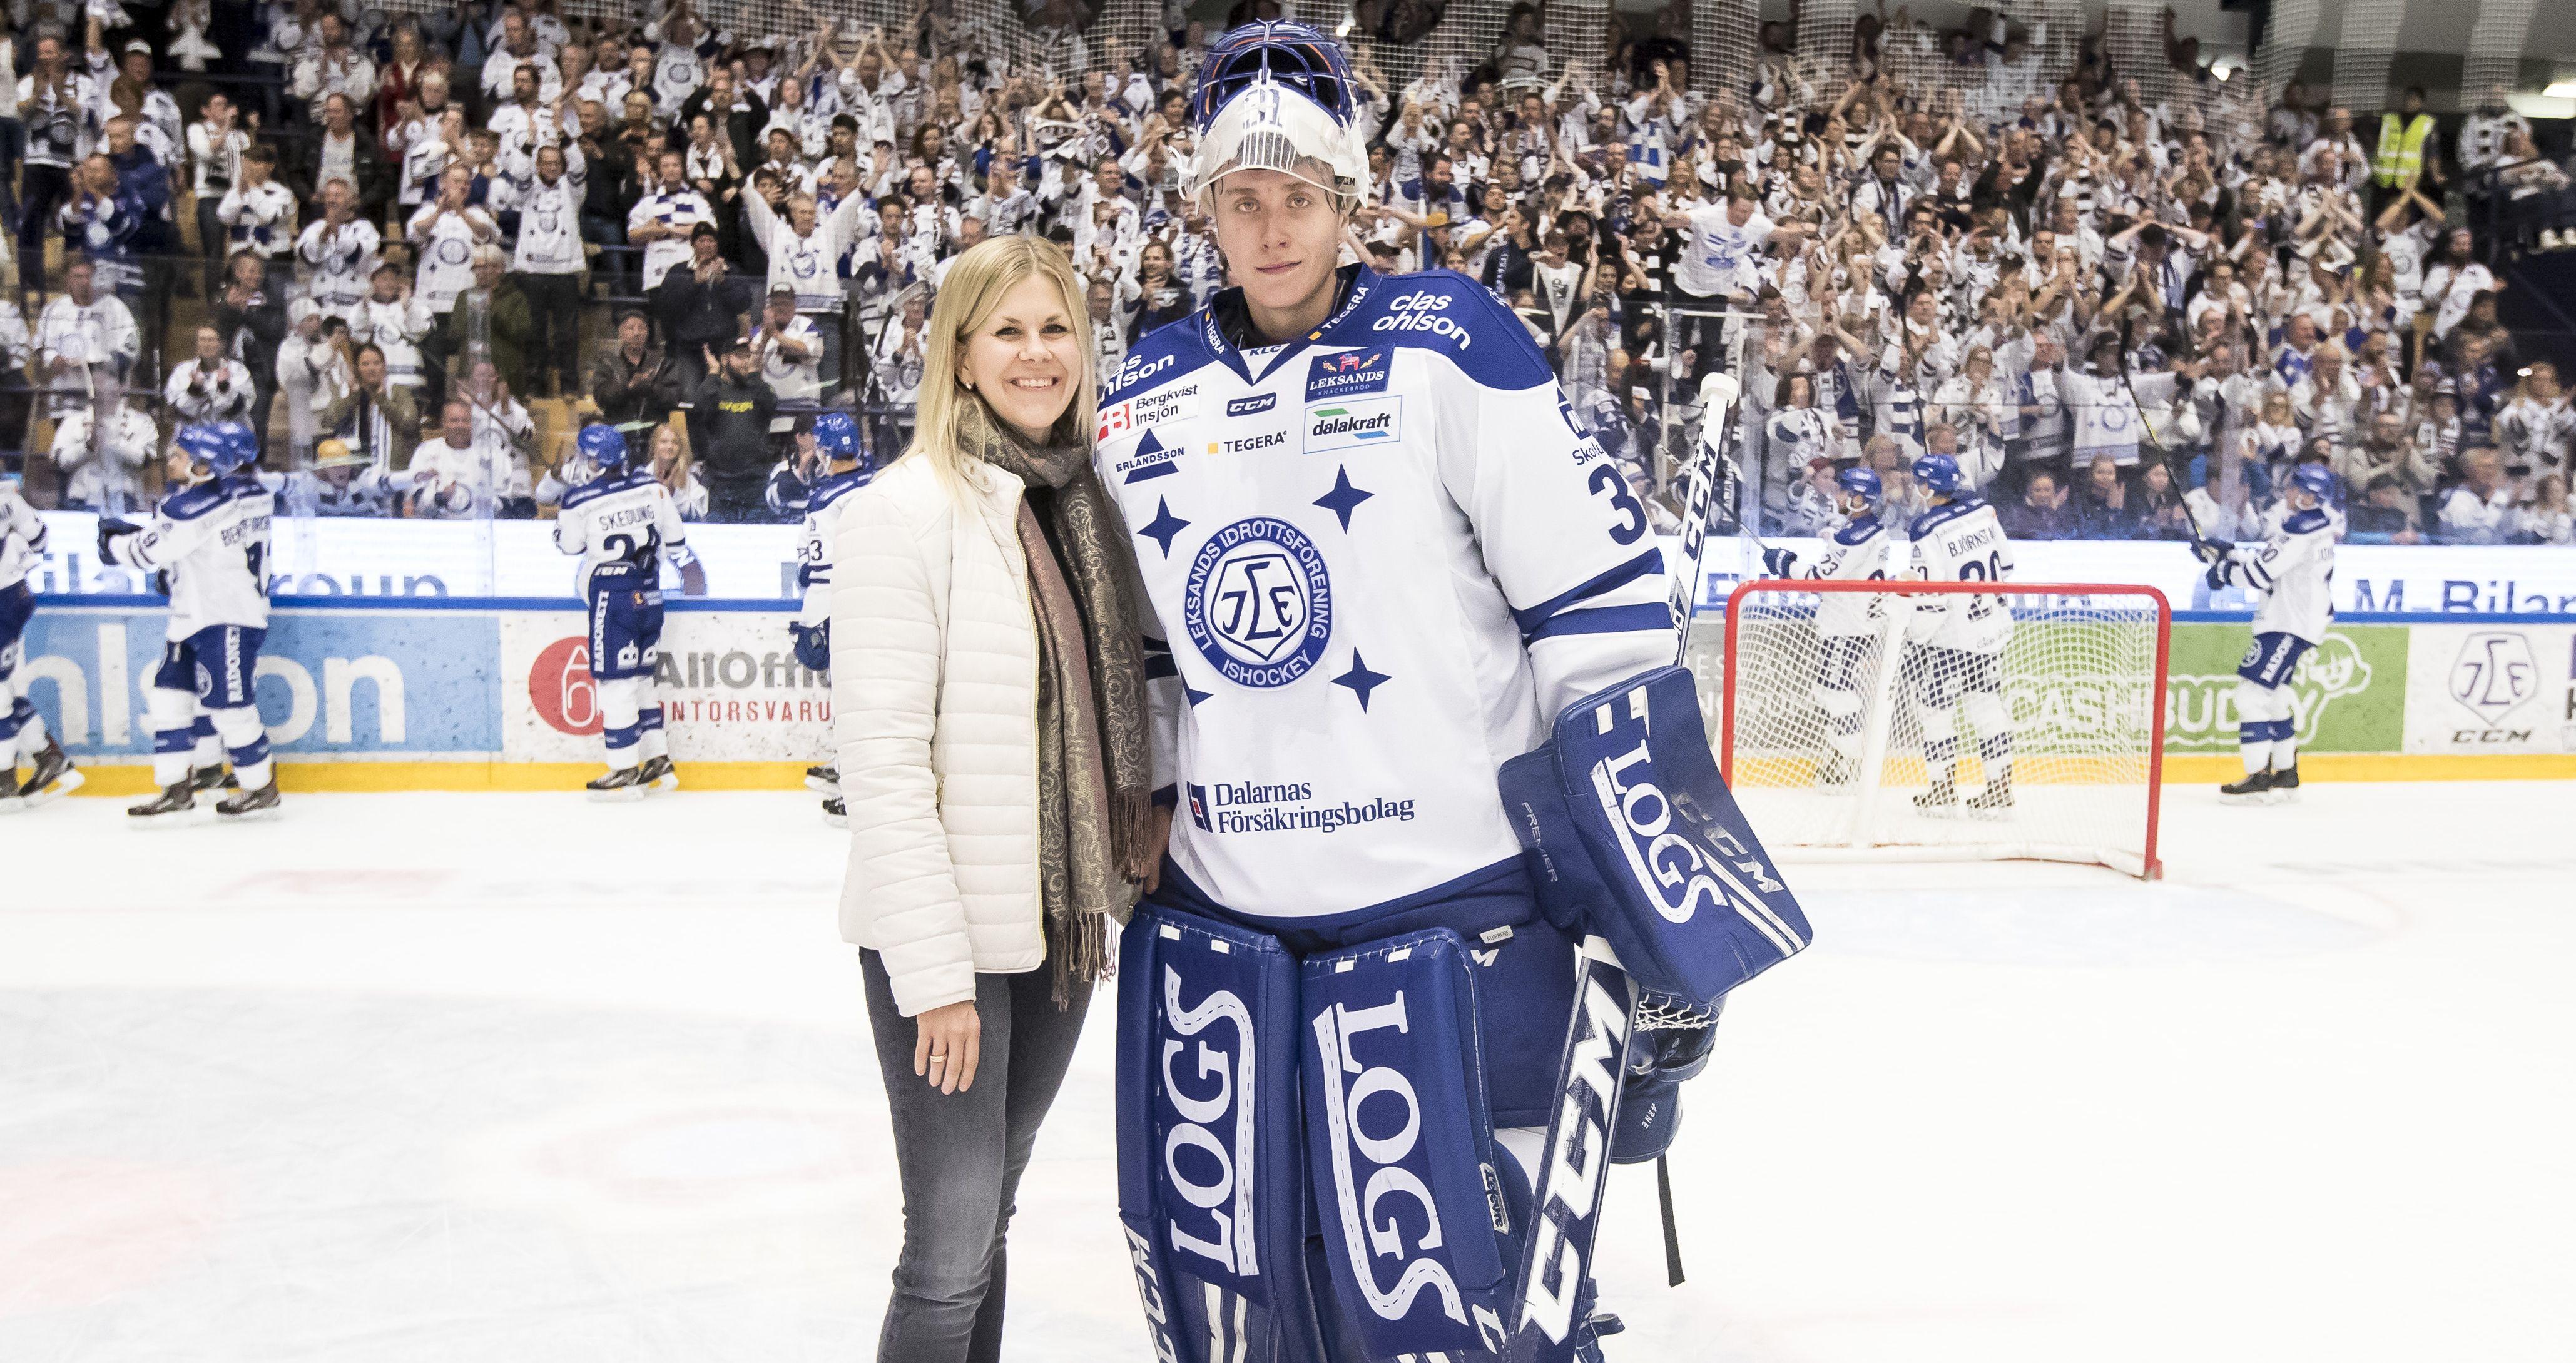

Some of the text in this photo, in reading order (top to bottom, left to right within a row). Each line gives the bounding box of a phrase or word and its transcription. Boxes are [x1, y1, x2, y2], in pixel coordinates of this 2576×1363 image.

[1321, 286, 1369, 330] TEGERA
[1390, 290, 1452, 311] clas
[1206, 318, 1225, 355] TEGERA
[1373, 310, 1471, 350] ohlson
[1101, 354, 1174, 403] hlson
[1136, 383, 1198, 410] Bergkvist
[1309, 370, 1385, 391] LEKSANDS
[1136, 405, 1179, 427] Insjön
[1229, 397, 1274, 412] CCM
[1313, 412, 1391, 436] dalakraft
[1116, 447, 1184, 472] ERLANDSSON
[1686, 439, 1716, 561] CCM
[1187, 520, 1331, 651] LEKSANDS IDROTTSFÖRENING
[1221, 650, 1314, 686] ISHOCKEY
[2452, 729, 2532, 742] CCM
[1214, 780, 1312, 807] Dalarnas
[1218, 796, 1415, 834] Försäkringsbolag
[1590, 739, 1729, 924] LOGS
[1669, 787, 1784, 893] CCM
[1162, 964, 1259, 1276] LOGS
[1313, 990, 1469, 1327] LOGS
[1519, 975, 1627, 1345] CCM
